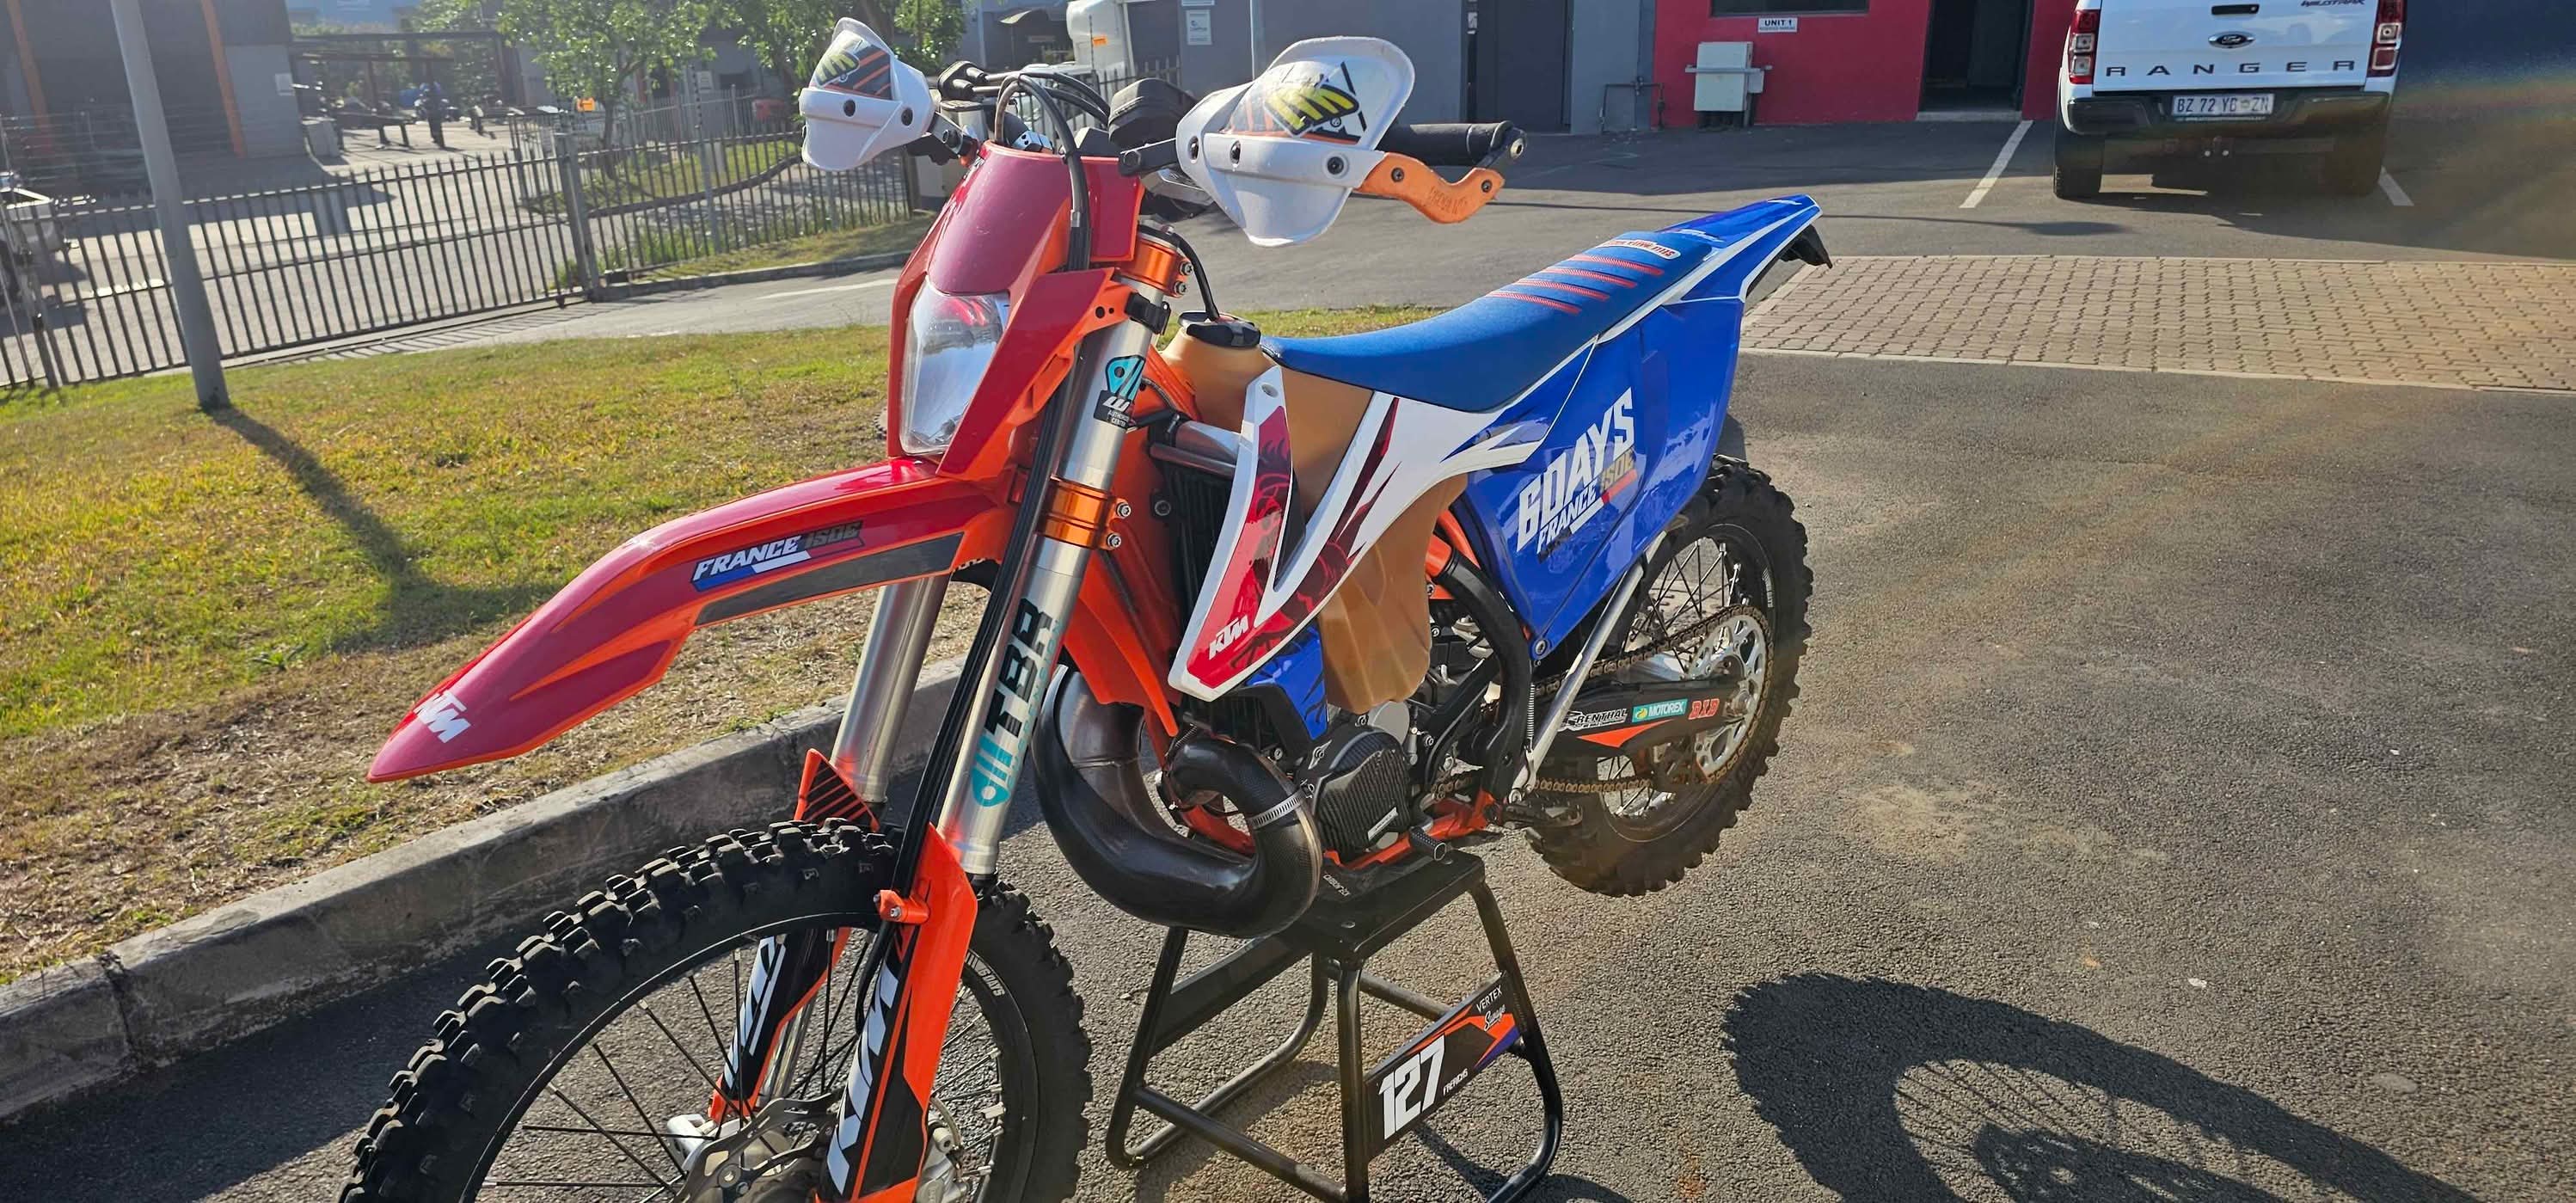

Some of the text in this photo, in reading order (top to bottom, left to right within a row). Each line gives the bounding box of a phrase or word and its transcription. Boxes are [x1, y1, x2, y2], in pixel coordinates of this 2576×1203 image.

[2106, 59, 2356, 77] RANGER
[2200, 97, 2216, 113] 72
[1537, 480, 1597, 554] FRANCE
[692, 522, 862, 581] FRANCE ISDE
[1209, 615, 1249, 660] KTM
[985, 598, 1053, 739] TBR
[413, 690, 471, 744] KTM
[1576, 709, 1628, 725] RENTHAL
[1648, 701, 1686, 718] MOTOREX
[1475, 985, 1503, 1014] VERTEX
[1378, 1034, 1445, 1140] 127
